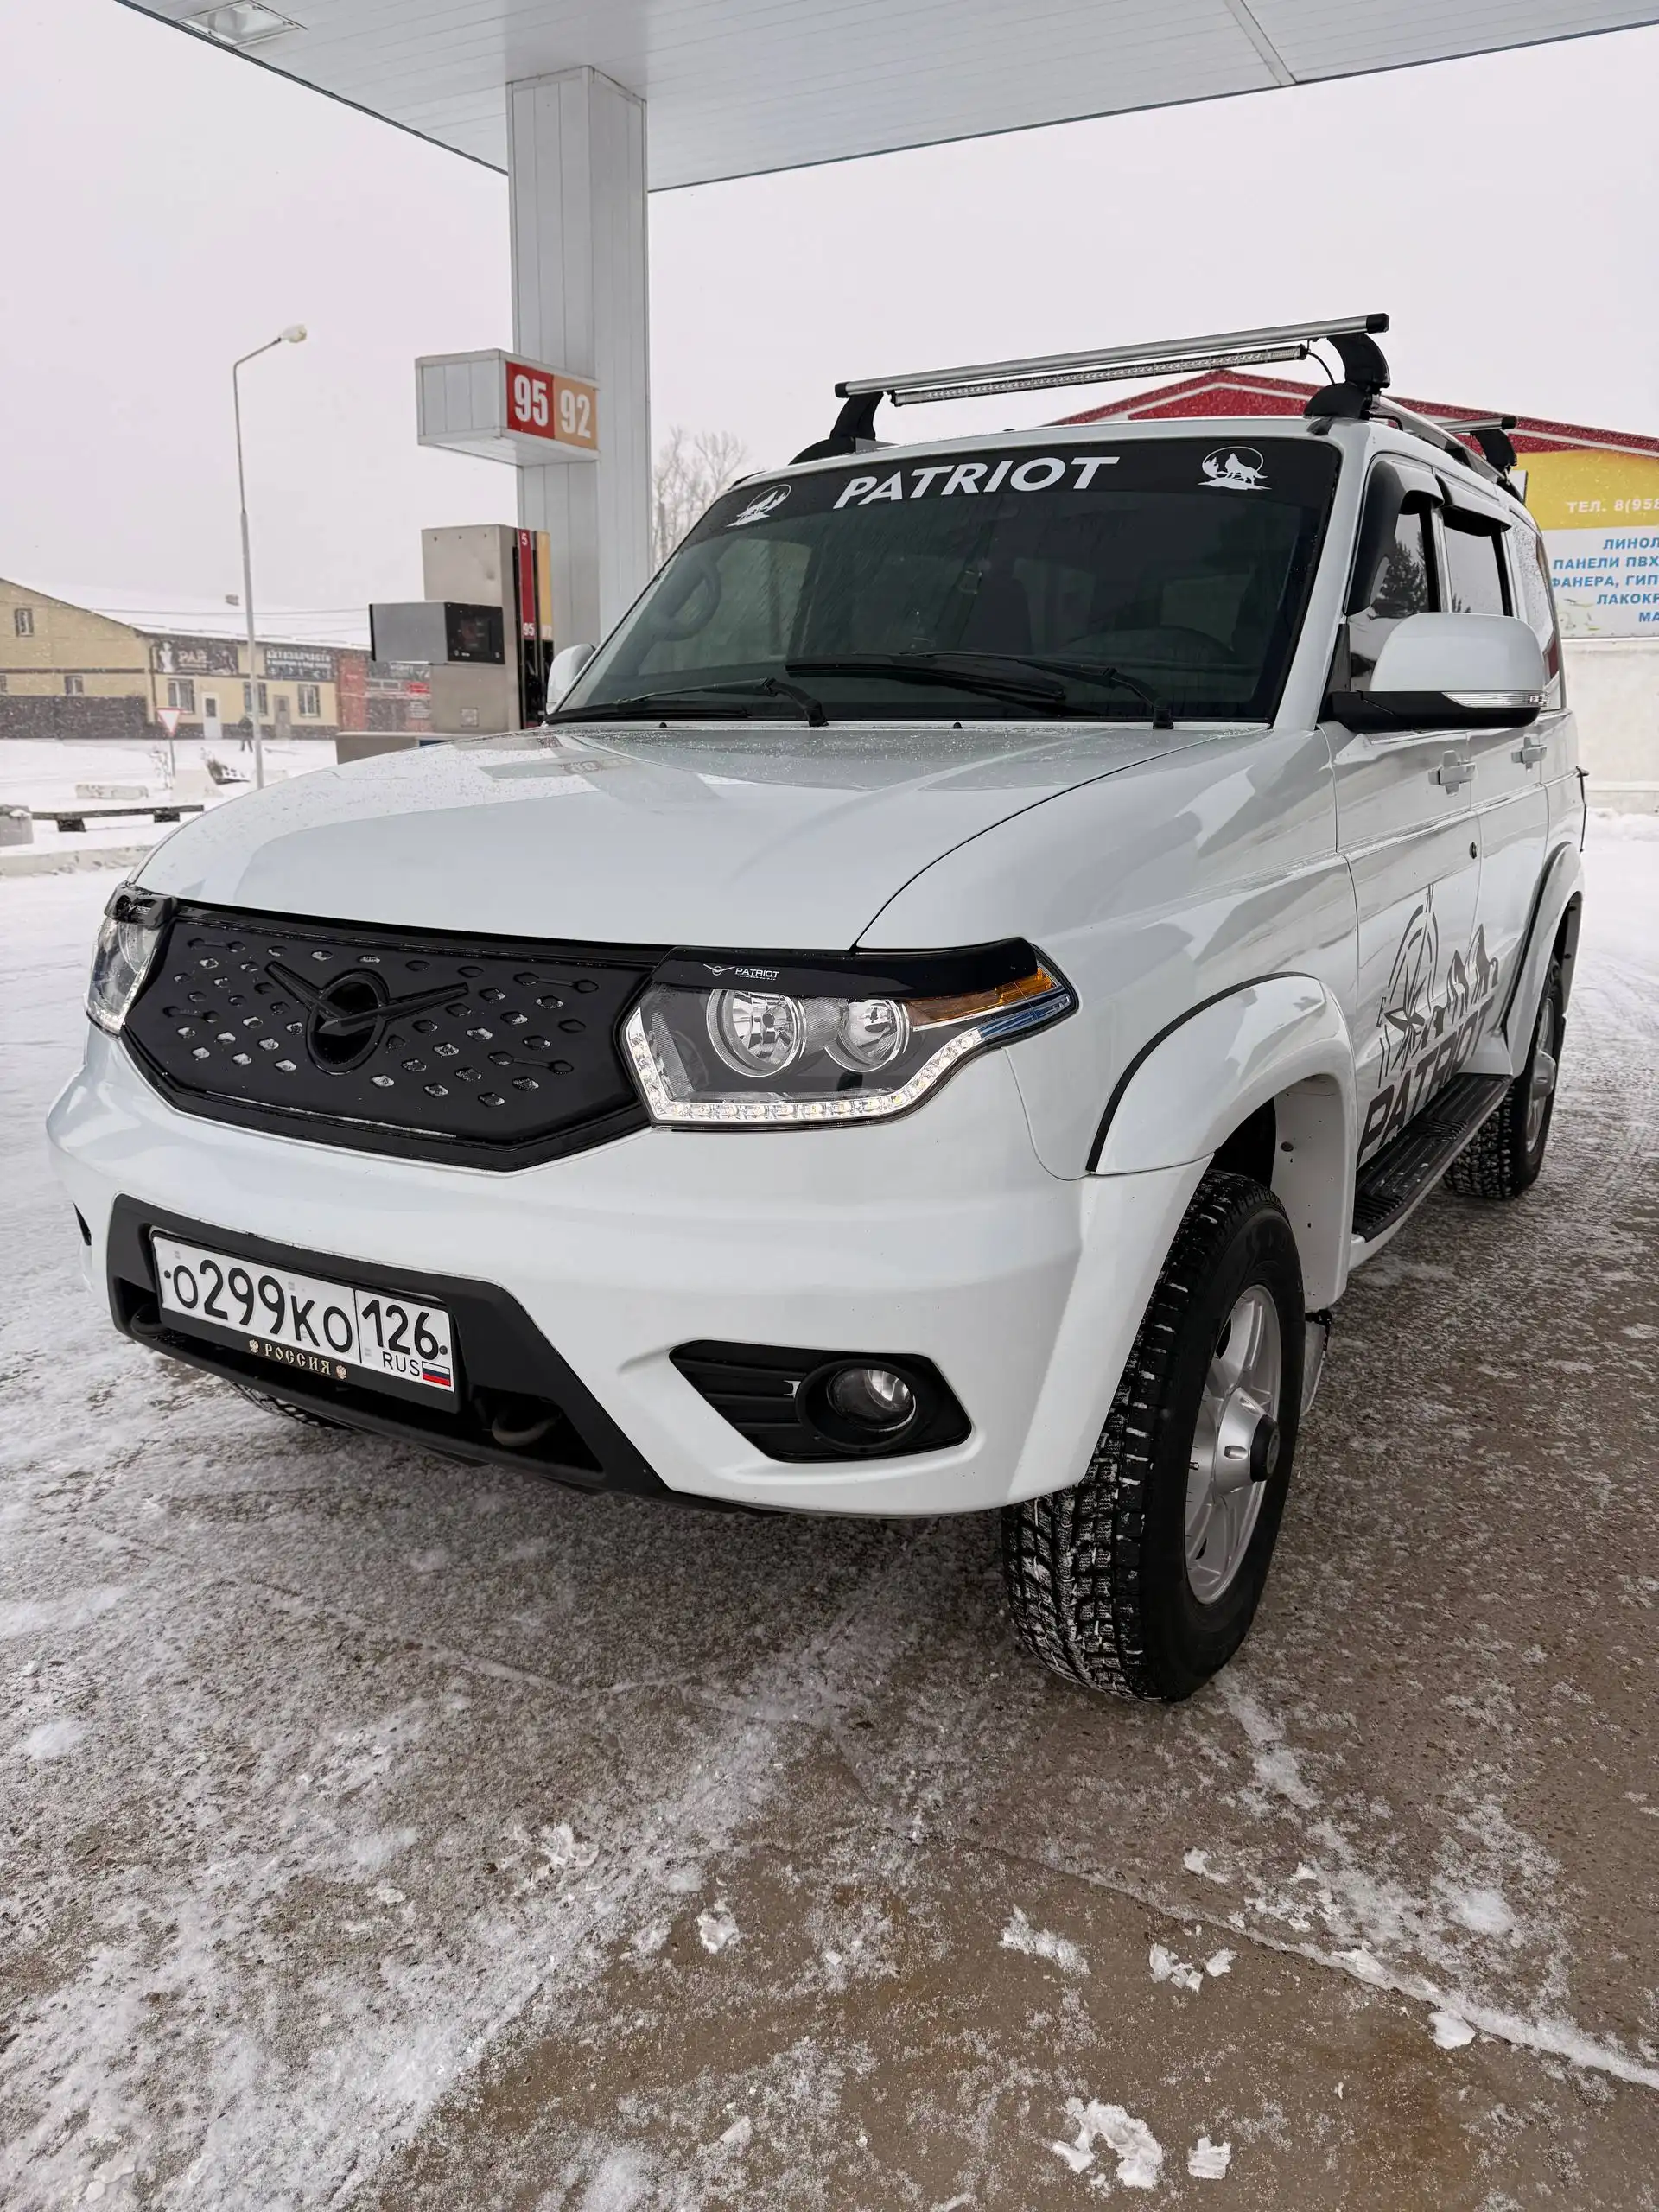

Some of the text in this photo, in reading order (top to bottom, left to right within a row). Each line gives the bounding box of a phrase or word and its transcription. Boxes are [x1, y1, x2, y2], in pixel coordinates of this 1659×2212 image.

[514, 374, 591, 438] 95 92
[833, 456, 1120, 509] PATRIOT
[1567, 500, 1606, 512] ТЕЛ.
[1603, 537, 1659, 550] ЛИНОЛ
[1553, 556, 1659, 569] ПАНЕЛИ ПВХ
[523, 622, 535, 637] 95
[735, 967, 779, 978] PATRIOT
[361, 1299, 439, 1360] 126
[264, 1344, 331, 1375] РОССИЯ
[382, 1351, 420, 1376] RUS
